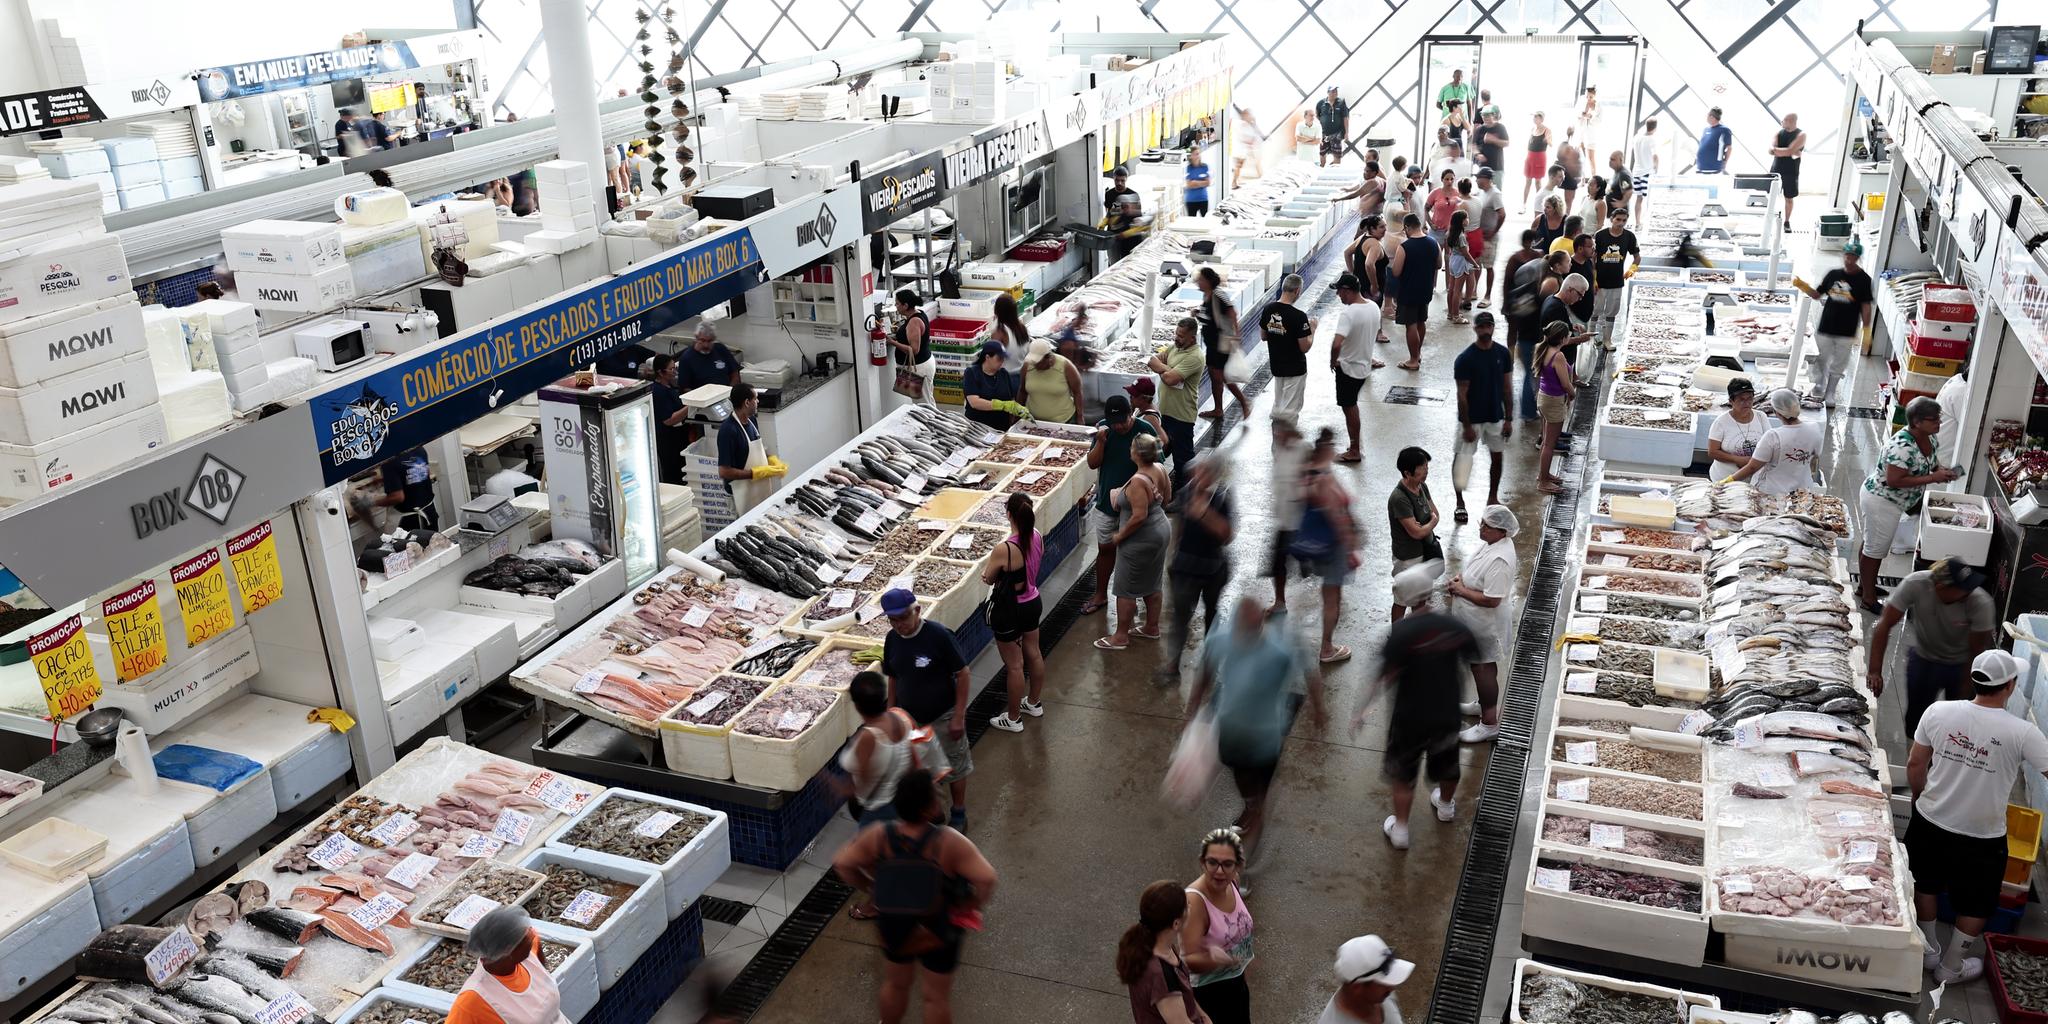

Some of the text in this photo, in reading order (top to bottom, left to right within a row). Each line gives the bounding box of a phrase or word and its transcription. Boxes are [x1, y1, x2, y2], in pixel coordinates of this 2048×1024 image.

[234, 57, 305, 86] EMANUEL
[306, 47, 378, 74] PESCADOS
[52, 100, 79, 109] Pescados
[132, 86, 166, 103] BOX 13
[946, 122, 1040, 188] VIEIRA PESCADOS
[870, 186, 896, 212] VIEIRA
[898, 170, 936, 200] PESCADOS
[796, 214, 832, 246] BOX 06
[40, 278, 80, 292] PESQUALI
[258, 288, 298, 302] MOWI
[402, 236, 748, 408] COMÉRCIO DE PESCADOS E FRUTOS DO MAR BOX 6
[48, 326, 114, 362] MOWI
[61, 382, 126, 418] MOWI
[332, 414, 356, 435] EDU
[332, 402, 398, 452] PESCADOS
[554, 417, 572, 432] TO
[334, 440, 370, 466] BOX 6
[554, 434, 574, 448] GO
[584, 420, 607, 508] Empanados
[130, 468, 234, 540] BOX 08
[228, 524, 271, 554] PROMOÇÃO
[173, 551, 218, 583] PROMOÇÃO
[232, 546, 260, 576] FILÉ
[176, 572, 223, 612] MARISCO
[241, 564, 276, 594] PANGA
[105, 584, 154, 615] PROMOÇÃO
[249, 582, 280, 612] 39,99
[30, 616, 81, 654] PROMOÇÃO
[107, 608, 142, 642] FILÉ
[112, 623, 162, 658] TILÁPIA
[193, 611, 231, 643] 24,99
[215, 660, 234, 674] ATLANTIC
[233, 650, 250, 664] SALMON
[45, 662, 94, 701] POSTAS
[154, 688, 185, 712] MULTI
[312, 834, 345, 861] DOURADO
[1776, 947, 1872, 973] MOWI
